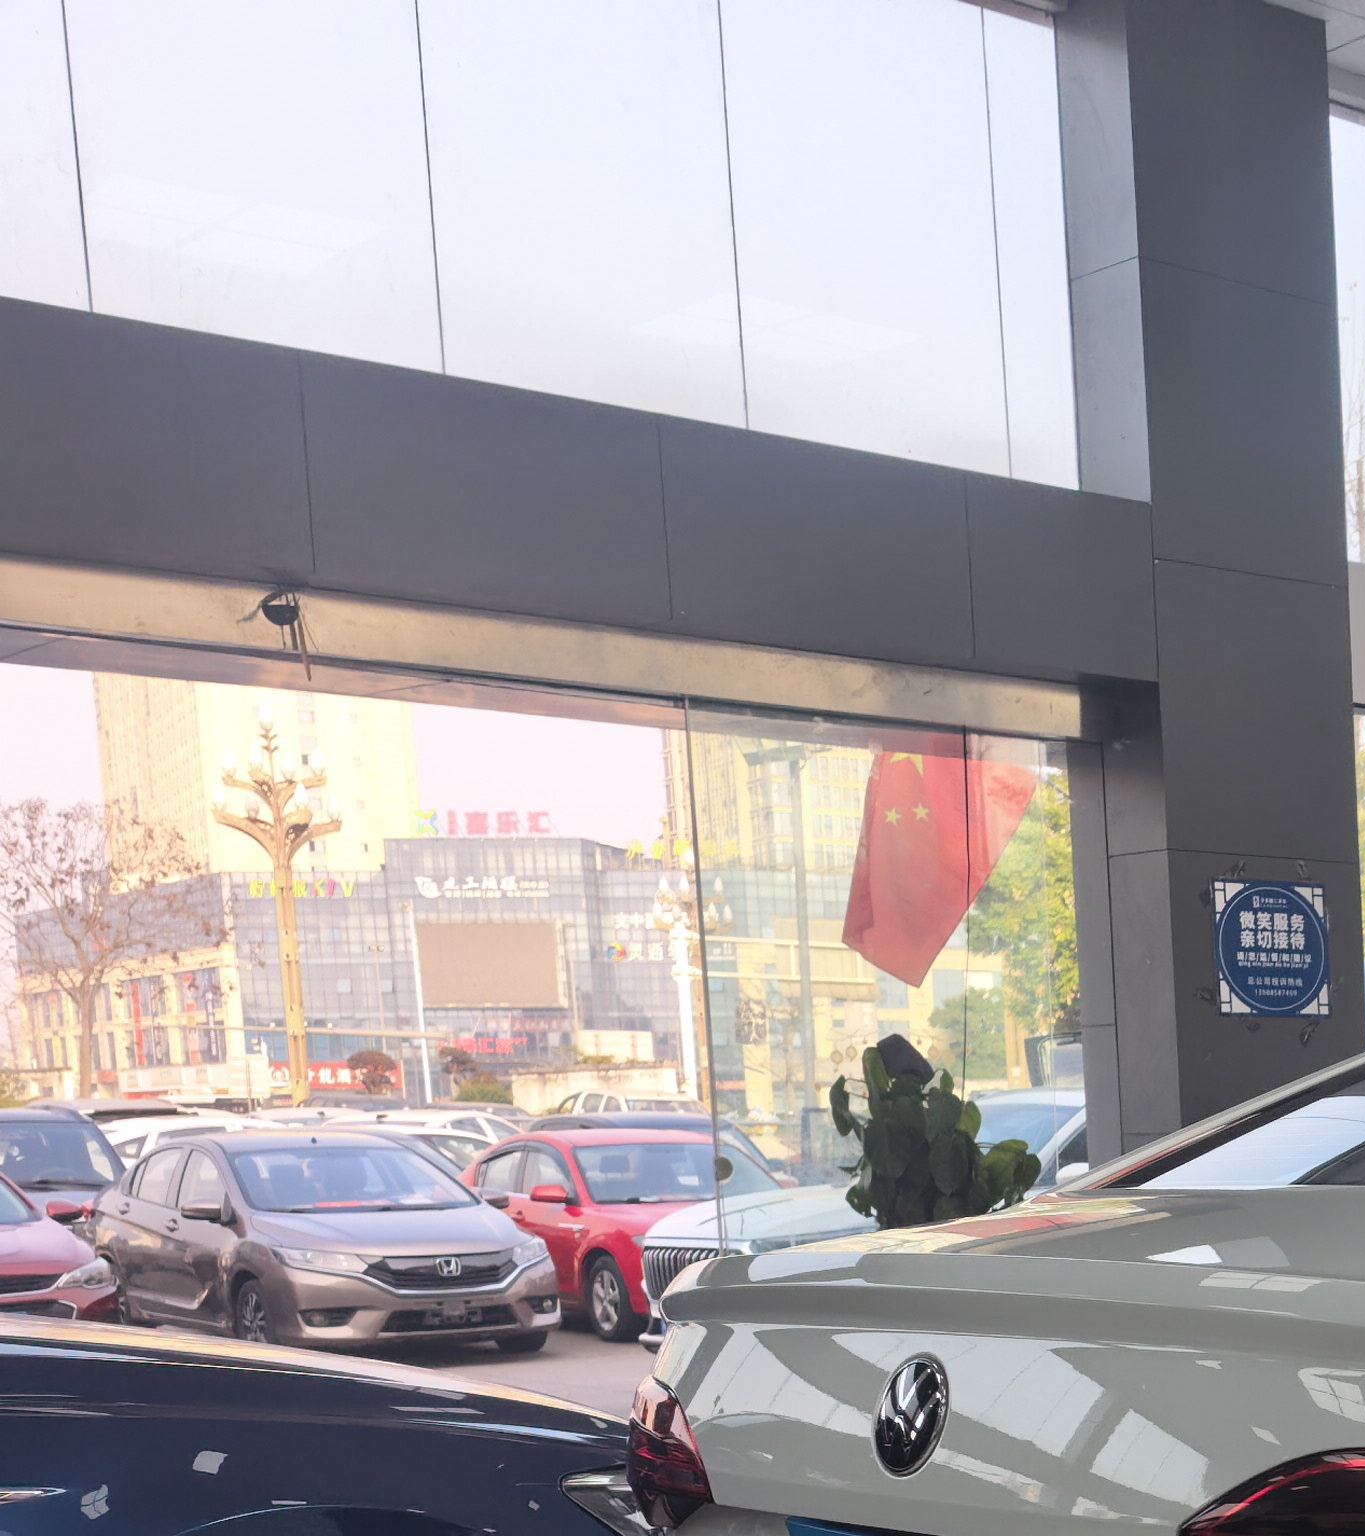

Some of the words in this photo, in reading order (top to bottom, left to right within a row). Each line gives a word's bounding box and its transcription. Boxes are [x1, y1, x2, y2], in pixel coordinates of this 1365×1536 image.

[1239, 911, 1304, 931] 微笑服务
[1240, 931, 1306, 950] 亲切接待
